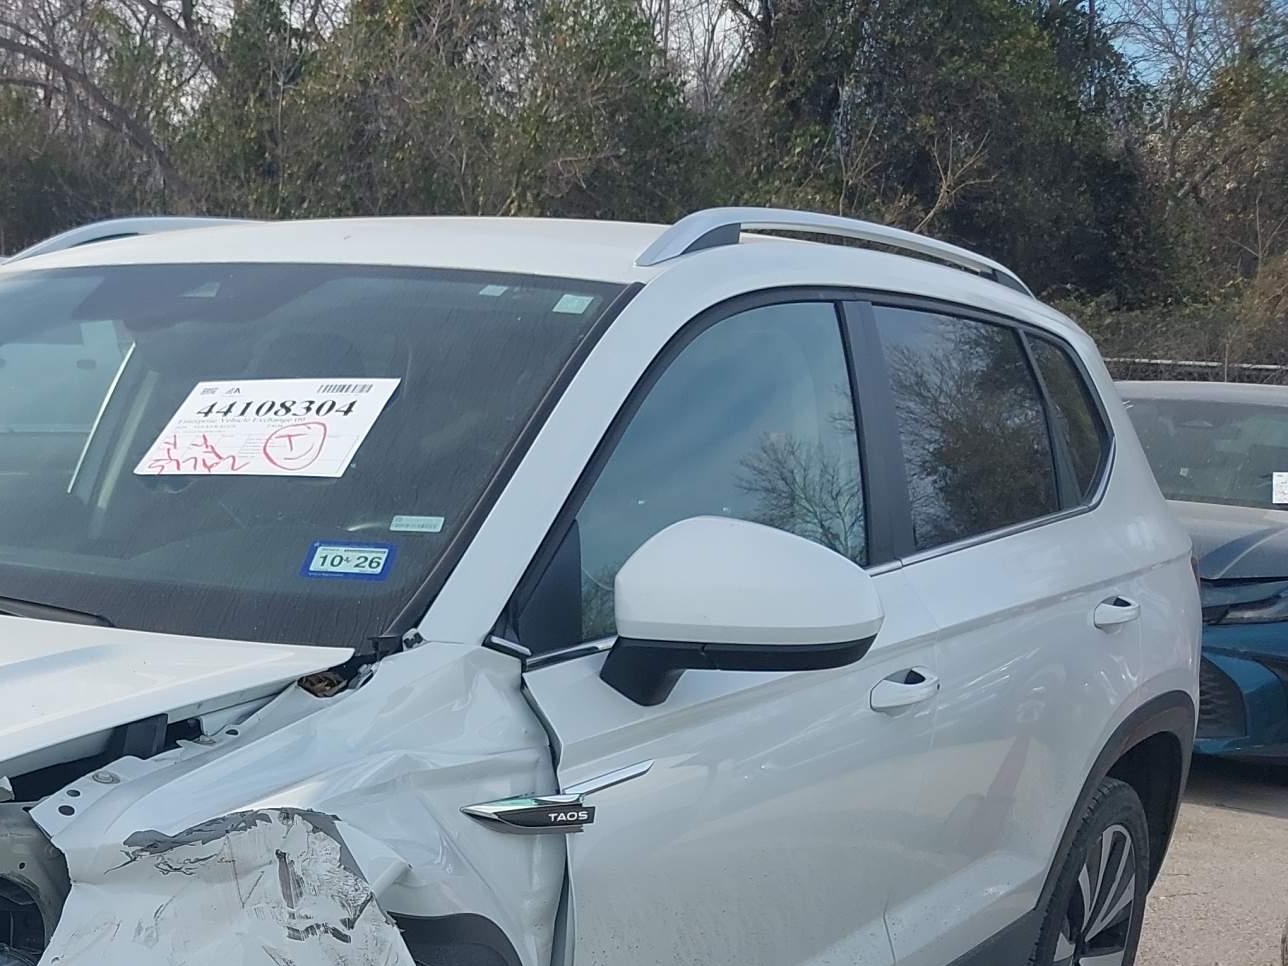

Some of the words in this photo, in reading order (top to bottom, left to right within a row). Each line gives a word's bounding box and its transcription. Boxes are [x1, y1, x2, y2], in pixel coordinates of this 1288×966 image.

[197, 399, 357, 418] 44108304
[319, 554, 344, 568] 10
[353, 555, 384, 570] 26
[548, 811, 589, 822] TAOS
